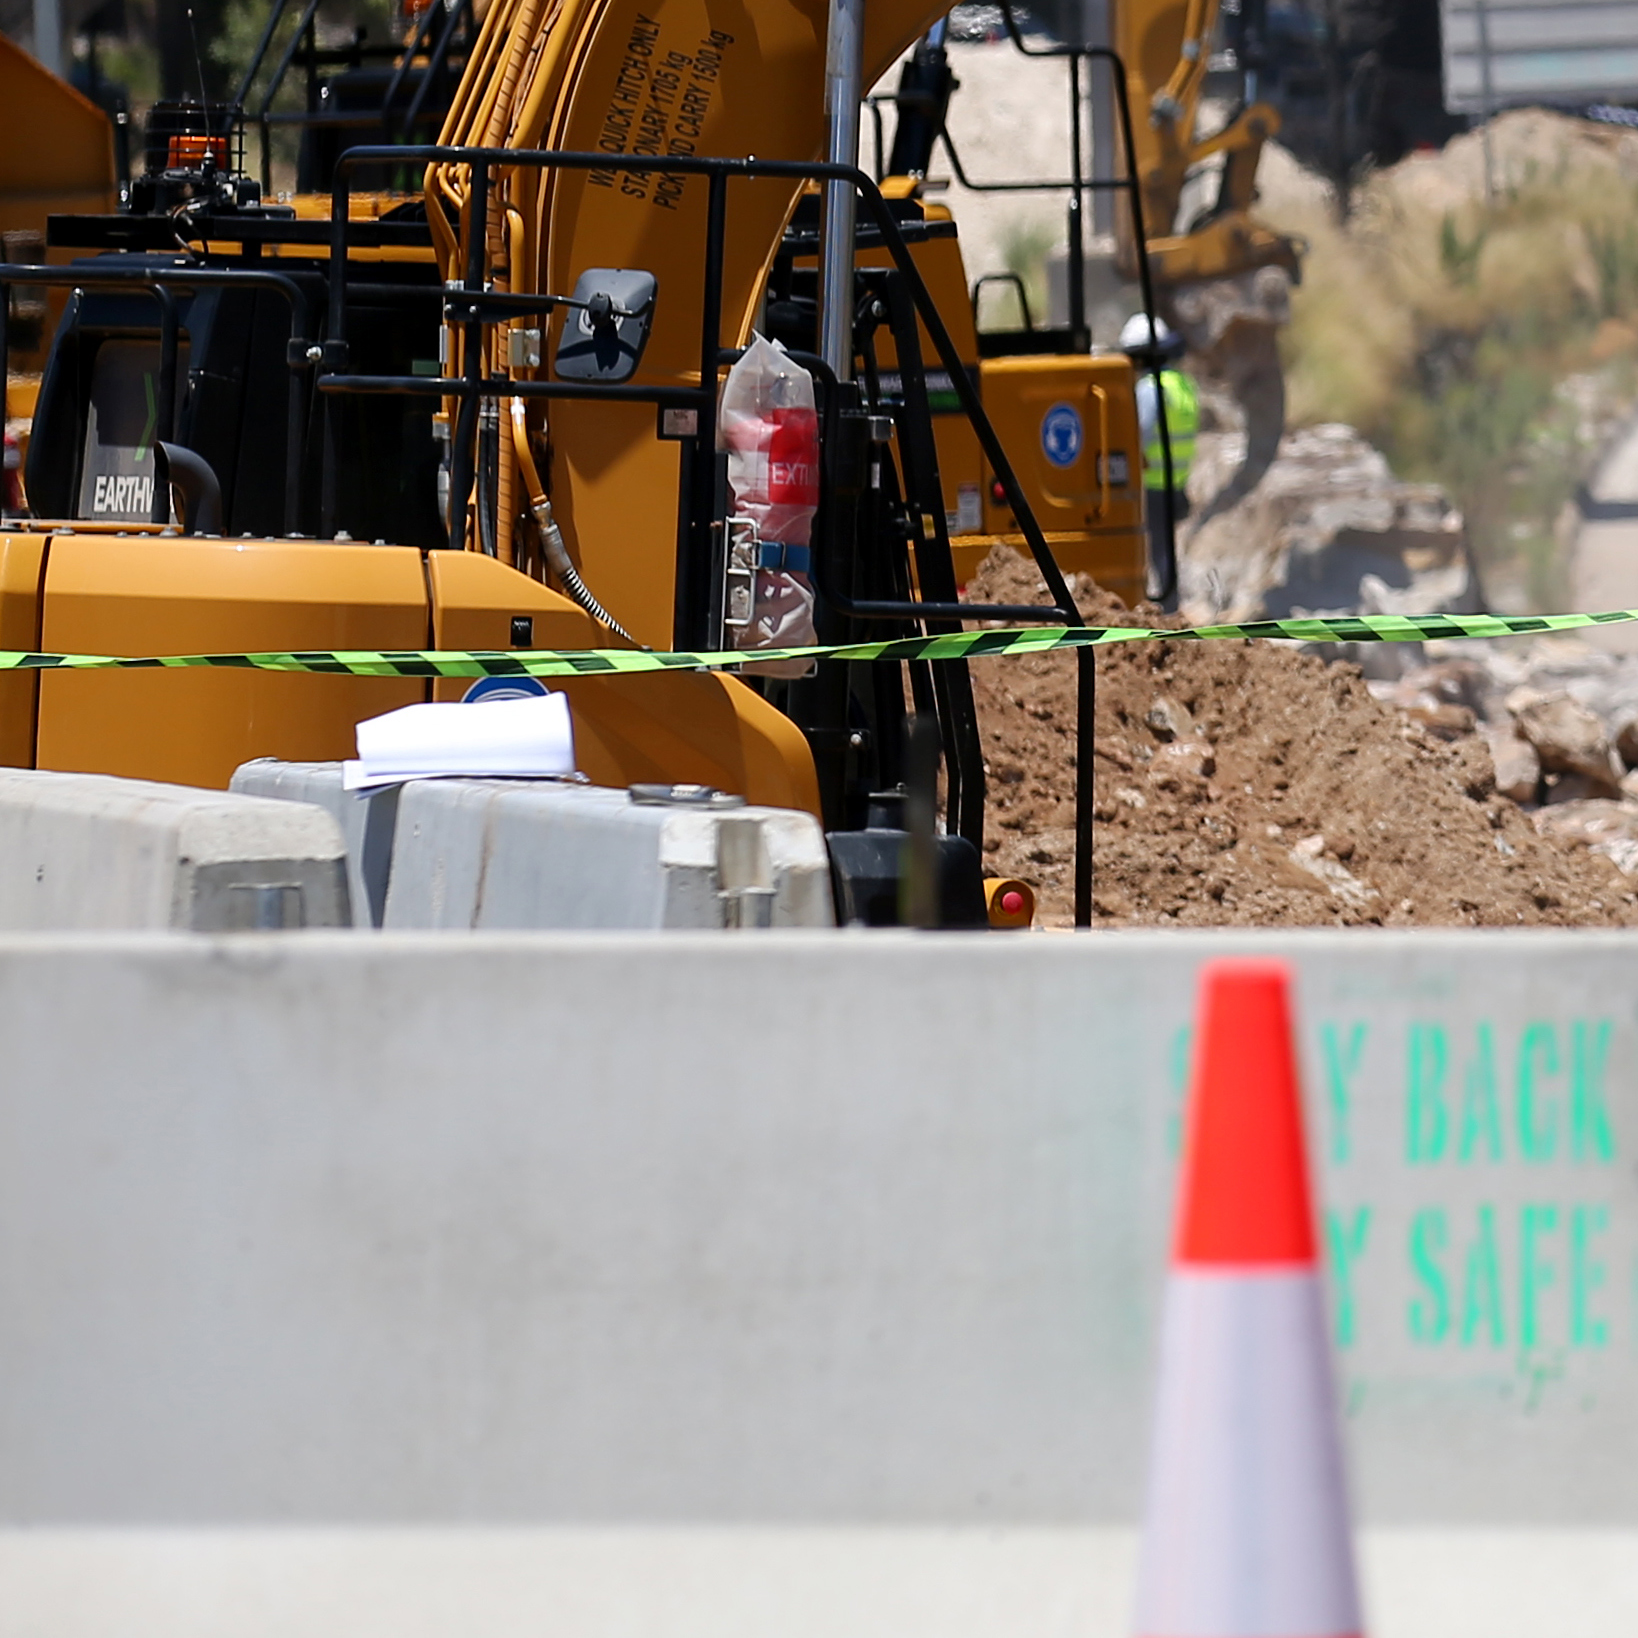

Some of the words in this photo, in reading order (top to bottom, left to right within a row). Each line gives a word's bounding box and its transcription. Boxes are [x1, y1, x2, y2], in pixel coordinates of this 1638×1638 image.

[628, 13, 661, 59] ONLY
[700, 29, 735, 50] kg
[613, 56, 649, 105] HITCH
[659, 50, 693, 72] kg
[691, 47, 723, 84] 1500
[650, 69, 681, 105] 1705
[674, 82, 711, 138] CARRY
[599, 102, 635, 155] QUICK
[621, 104, 669, 199] STAONARY
[652, 170, 687, 211] PICK
[1408, 1018, 1617, 1165] BACK
[1410, 1205, 1611, 1348] SAFE
